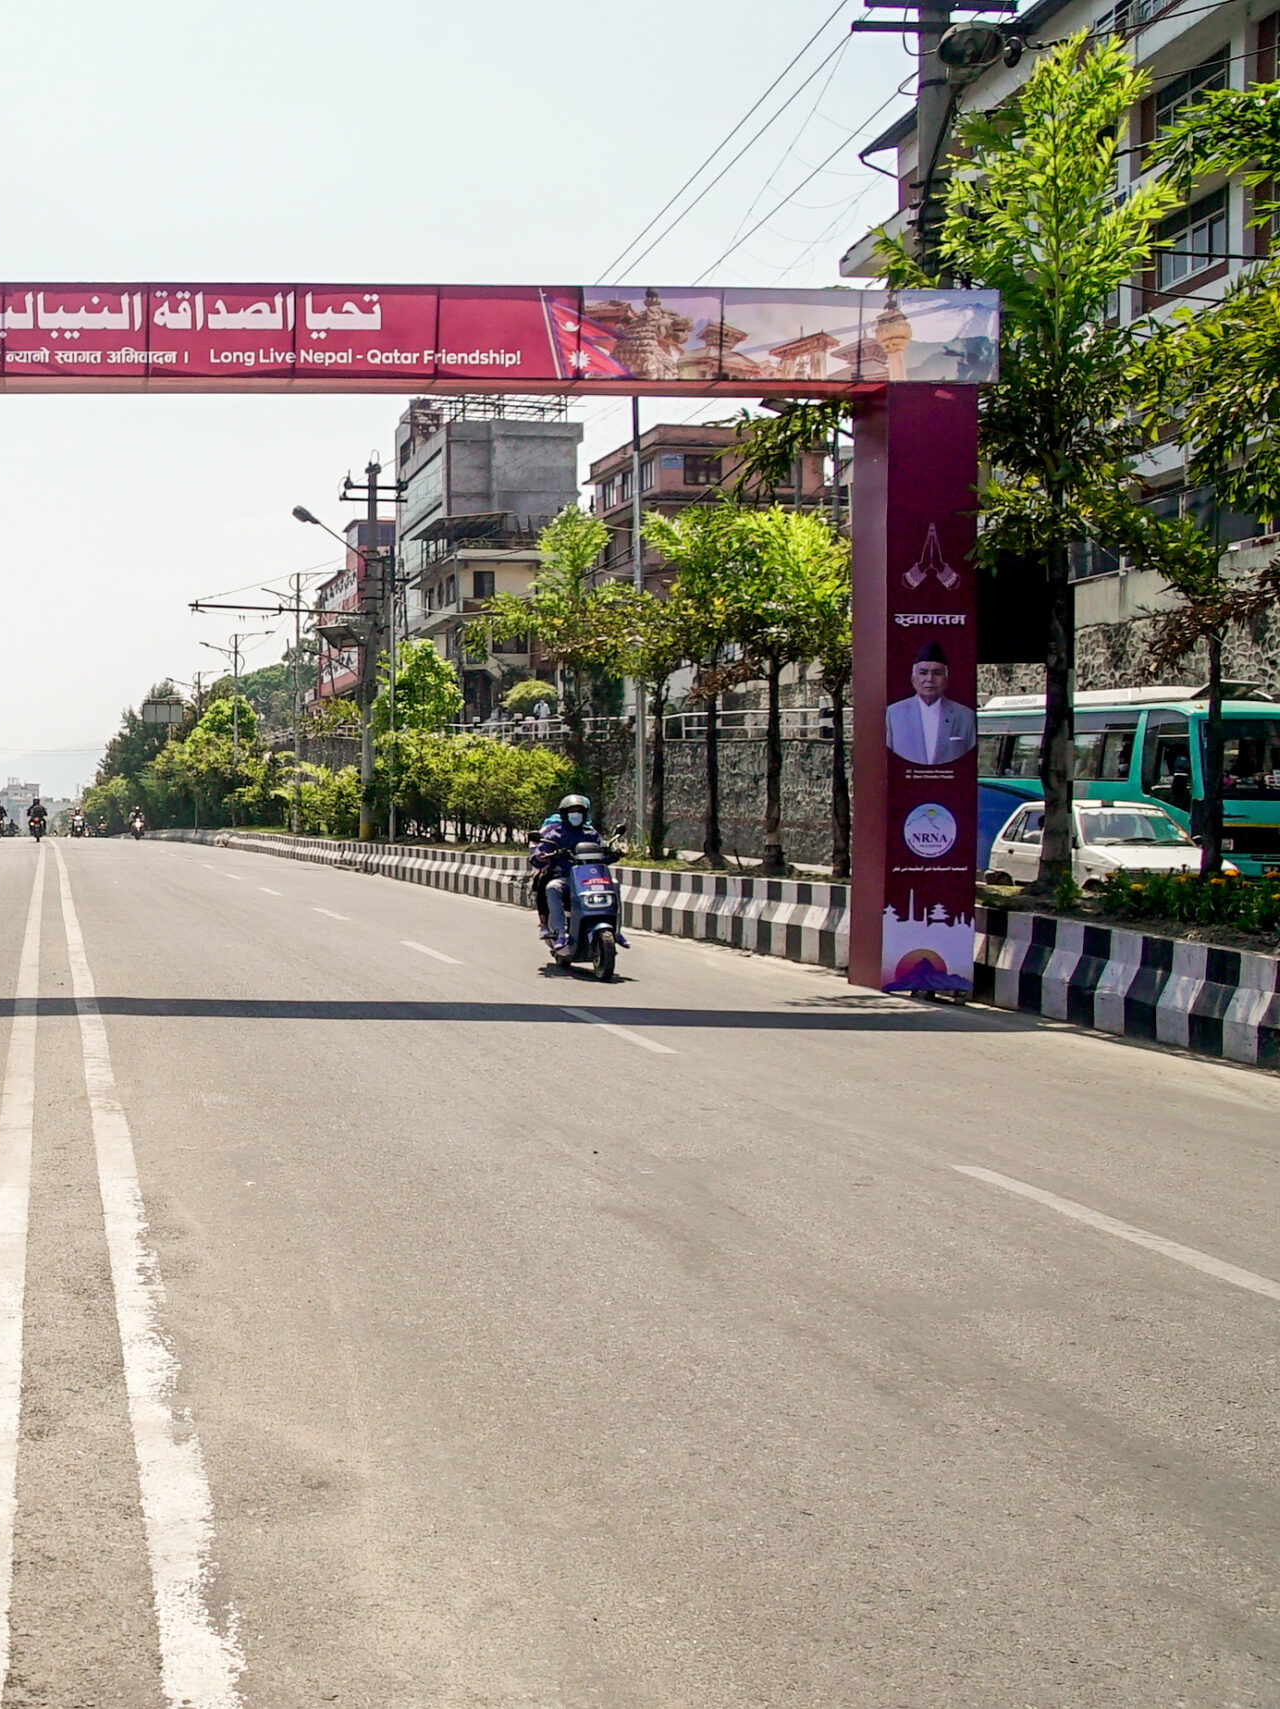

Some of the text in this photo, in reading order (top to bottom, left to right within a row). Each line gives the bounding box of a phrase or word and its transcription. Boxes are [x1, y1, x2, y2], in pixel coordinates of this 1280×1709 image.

[153, 291, 296, 332] الصداقة
[305, 291, 382, 340] تحيا
[5, 347, 50, 364] न्यानो
[54, 350, 101, 364] स्वागत
[106, 347, 177, 365] अभिवादन
[209, 348, 255, 366] Long
[259, 348, 296, 364] Live
[300, 348, 352, 367] Nepal
[366, 349, 420, 365] Qatar
[423, 349, 521, 368] Friendship!
[894, 613, 967, 627] स्वागतम
[912, 832, 947, 843] NRNA
